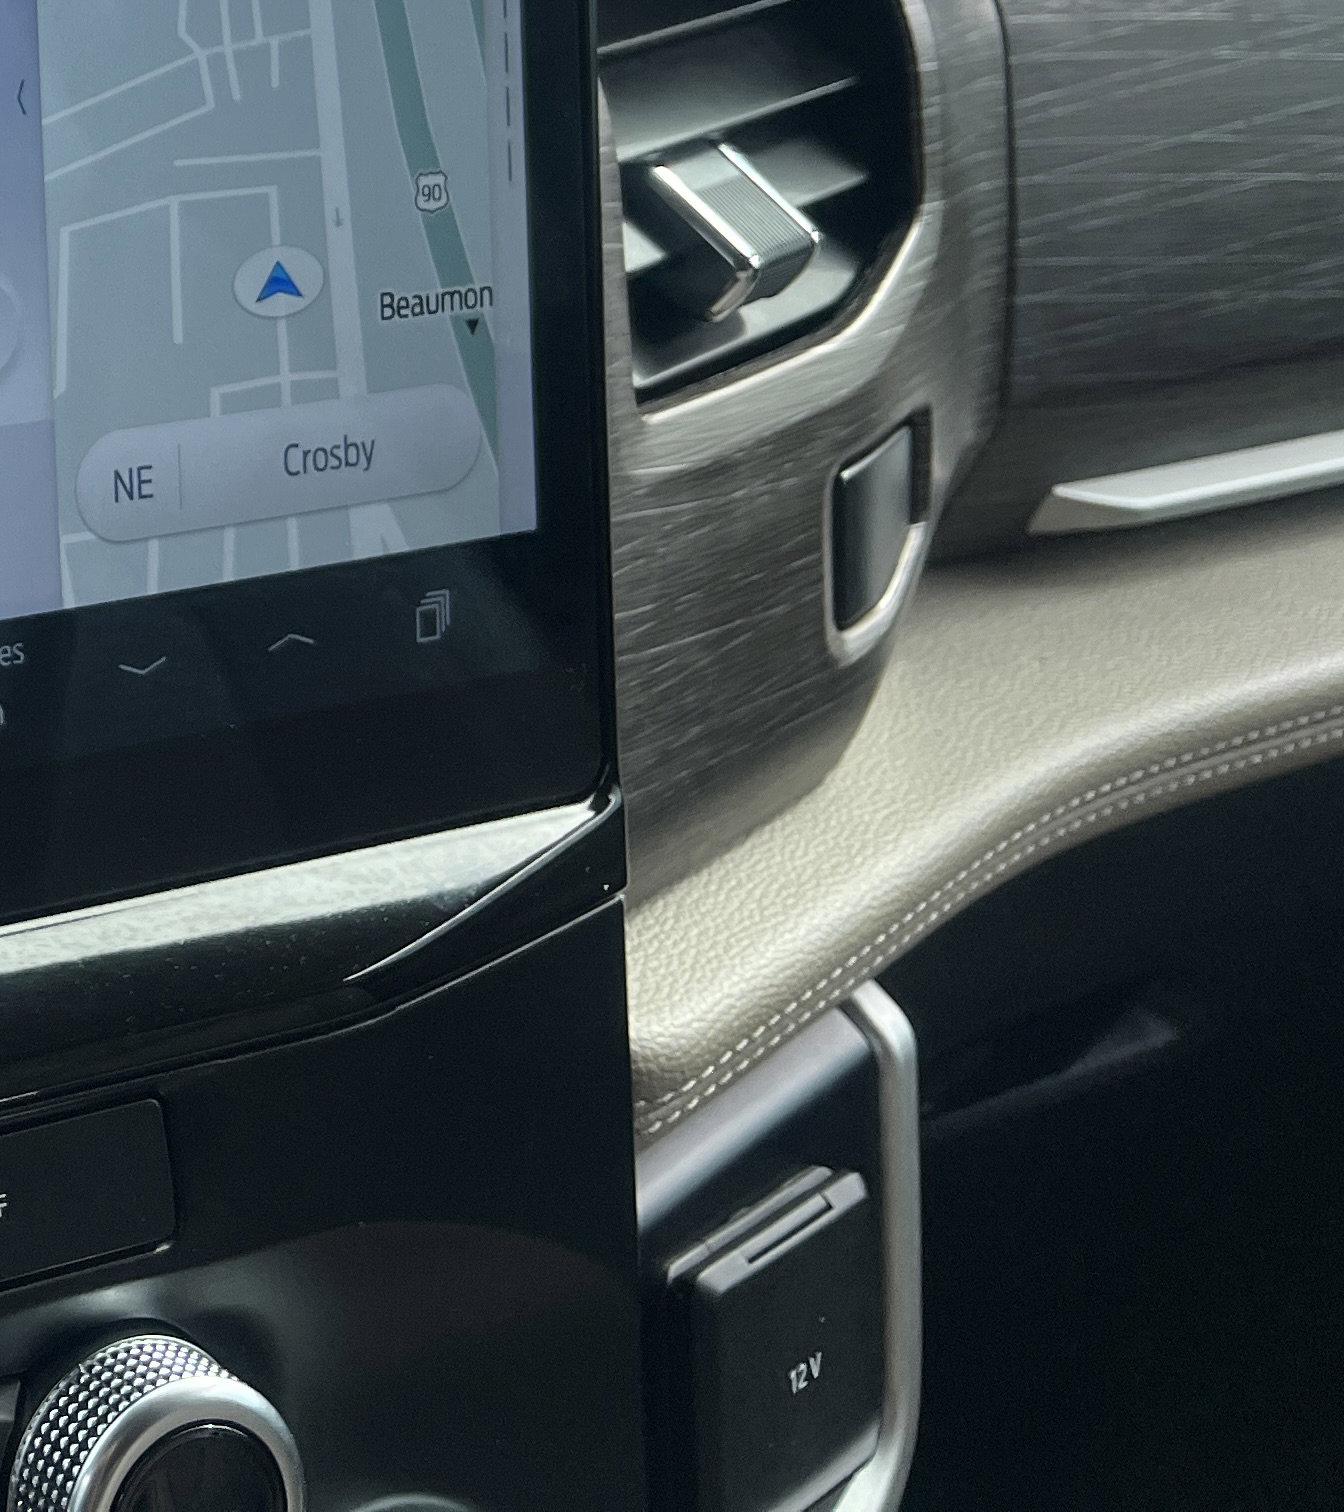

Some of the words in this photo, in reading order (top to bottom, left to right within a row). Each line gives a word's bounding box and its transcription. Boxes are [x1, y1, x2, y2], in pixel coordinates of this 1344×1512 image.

[421, 183, 443, 203] 90
[379, 285, 494, 322] Beaumon
[112, 465, 155, 505] NE
[282, 435, 377, 479] Crosby
